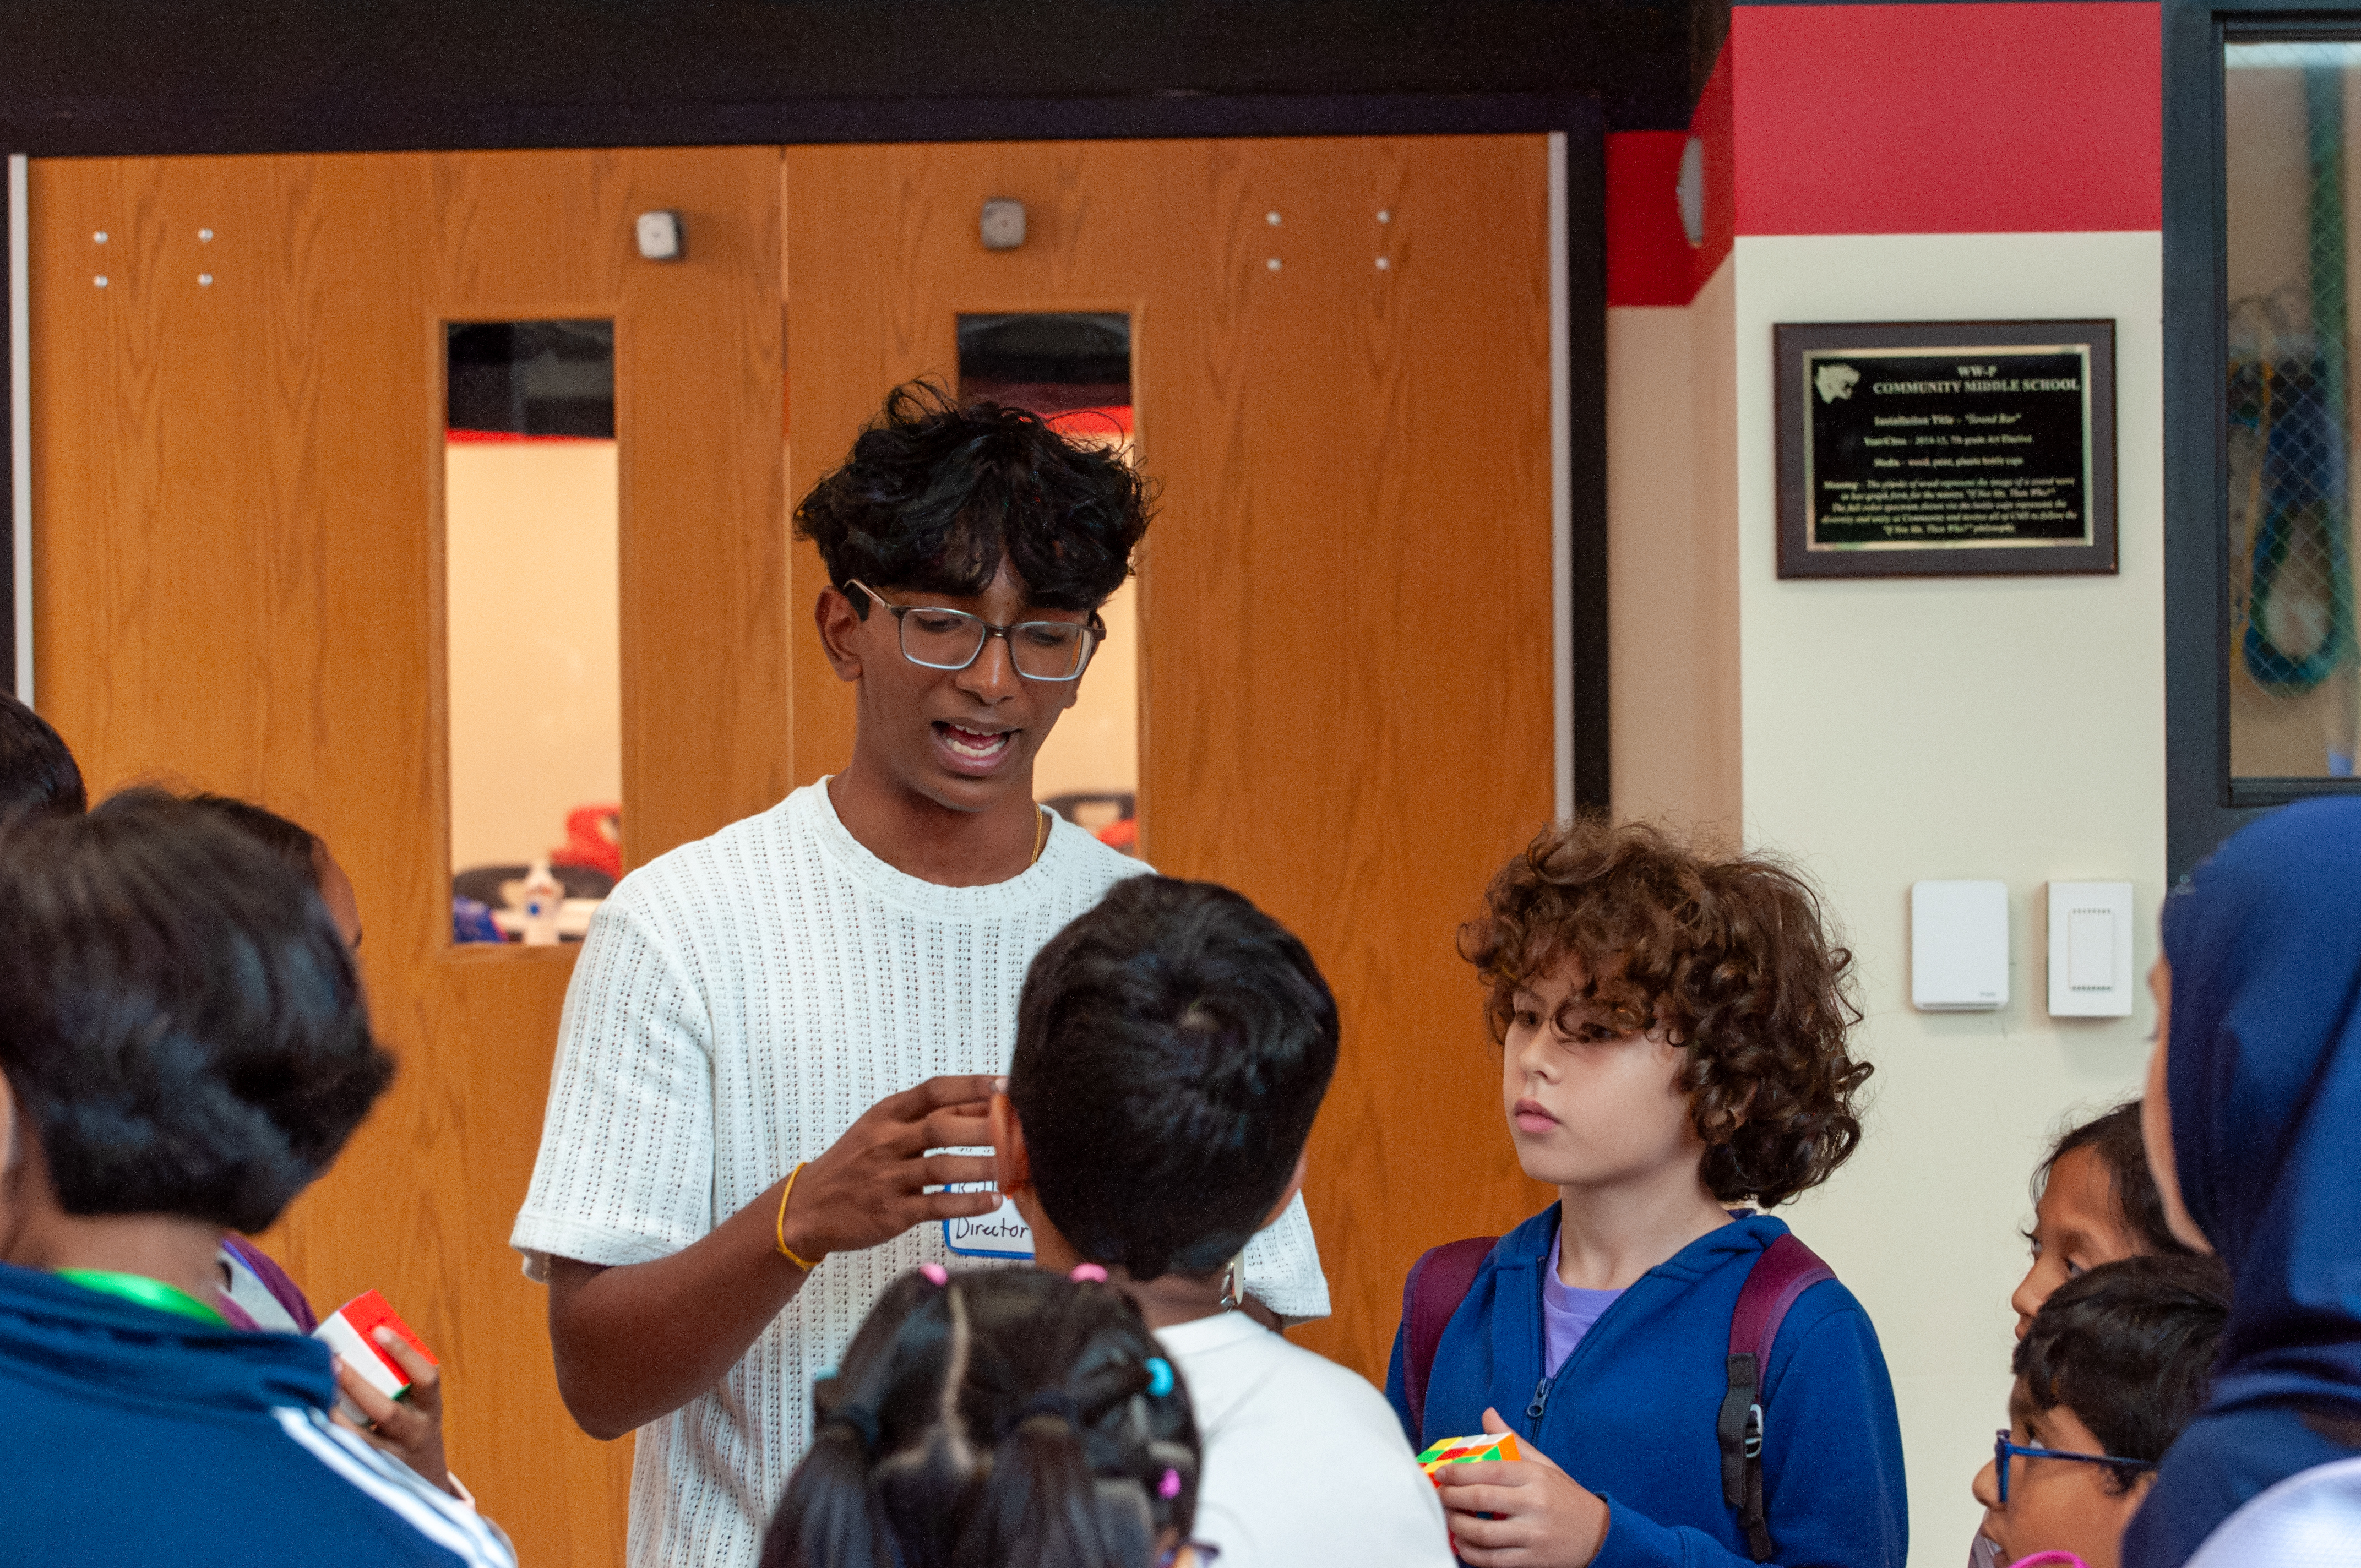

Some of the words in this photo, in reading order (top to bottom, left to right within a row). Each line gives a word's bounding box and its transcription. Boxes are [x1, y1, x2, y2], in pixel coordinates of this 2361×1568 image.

[1957, 365, 1998, 378] WW-P
[1873, 380, 1961, 394] COMMUNITY
[1964, 379, 2020, 393] MIDDLE
[2022, 378, 2080, 391] SCHOOL
[956, 1217, 1029, 1239] Director
